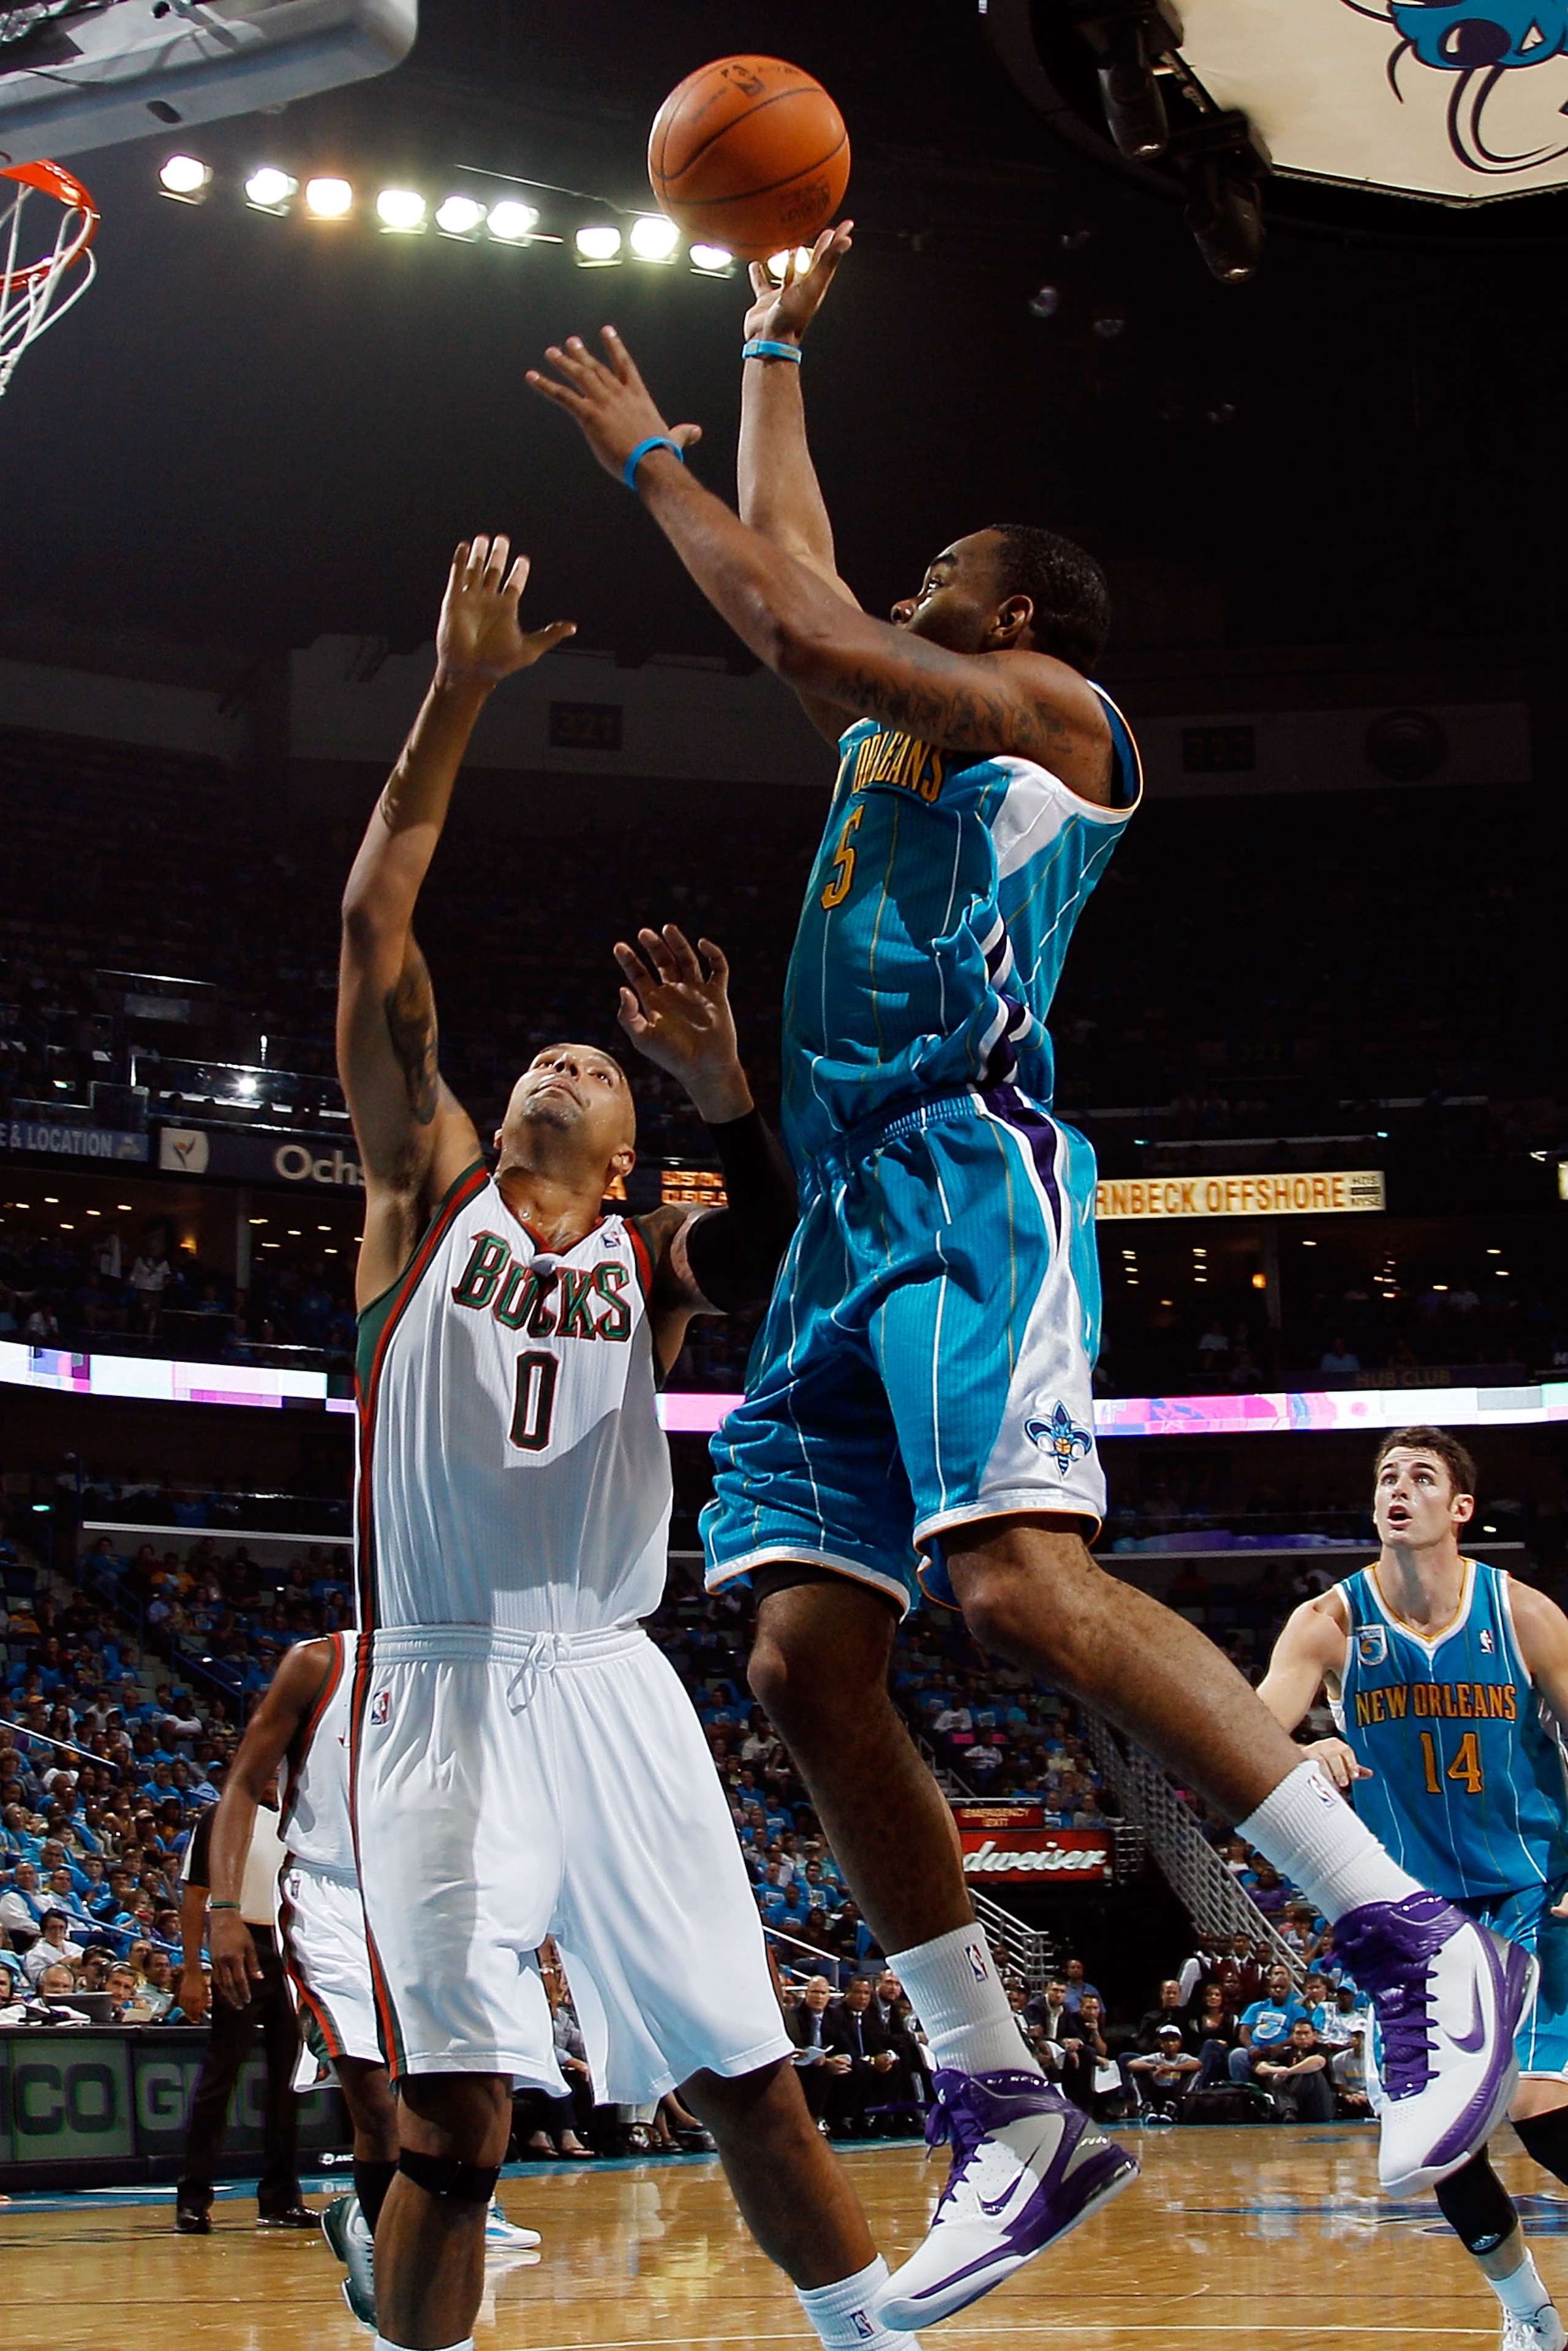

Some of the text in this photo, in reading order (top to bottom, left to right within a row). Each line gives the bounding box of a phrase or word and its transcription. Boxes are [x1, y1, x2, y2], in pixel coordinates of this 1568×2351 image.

[820, 802, 865, 911] 5
[27, 1125, 113, 1158] LOCATION
[1205, 1176, 1347, 1213] OFFSHORE
[451, 1229, 632, 1342] BUCKS
[1400, 1369, 1451, 1386] CLUB
[508, 1348, 562, 1454] 0
[1354, 1683, 1518, 1727] NEW ORLEANS
[1419, 1731, 1483, 1795] 14
[960, 1808, 1030, 1818] EMERGENCY
[981, 1817, 1009, 1827] EXIT
[963, 1840, 1107, 1872] dweiser
